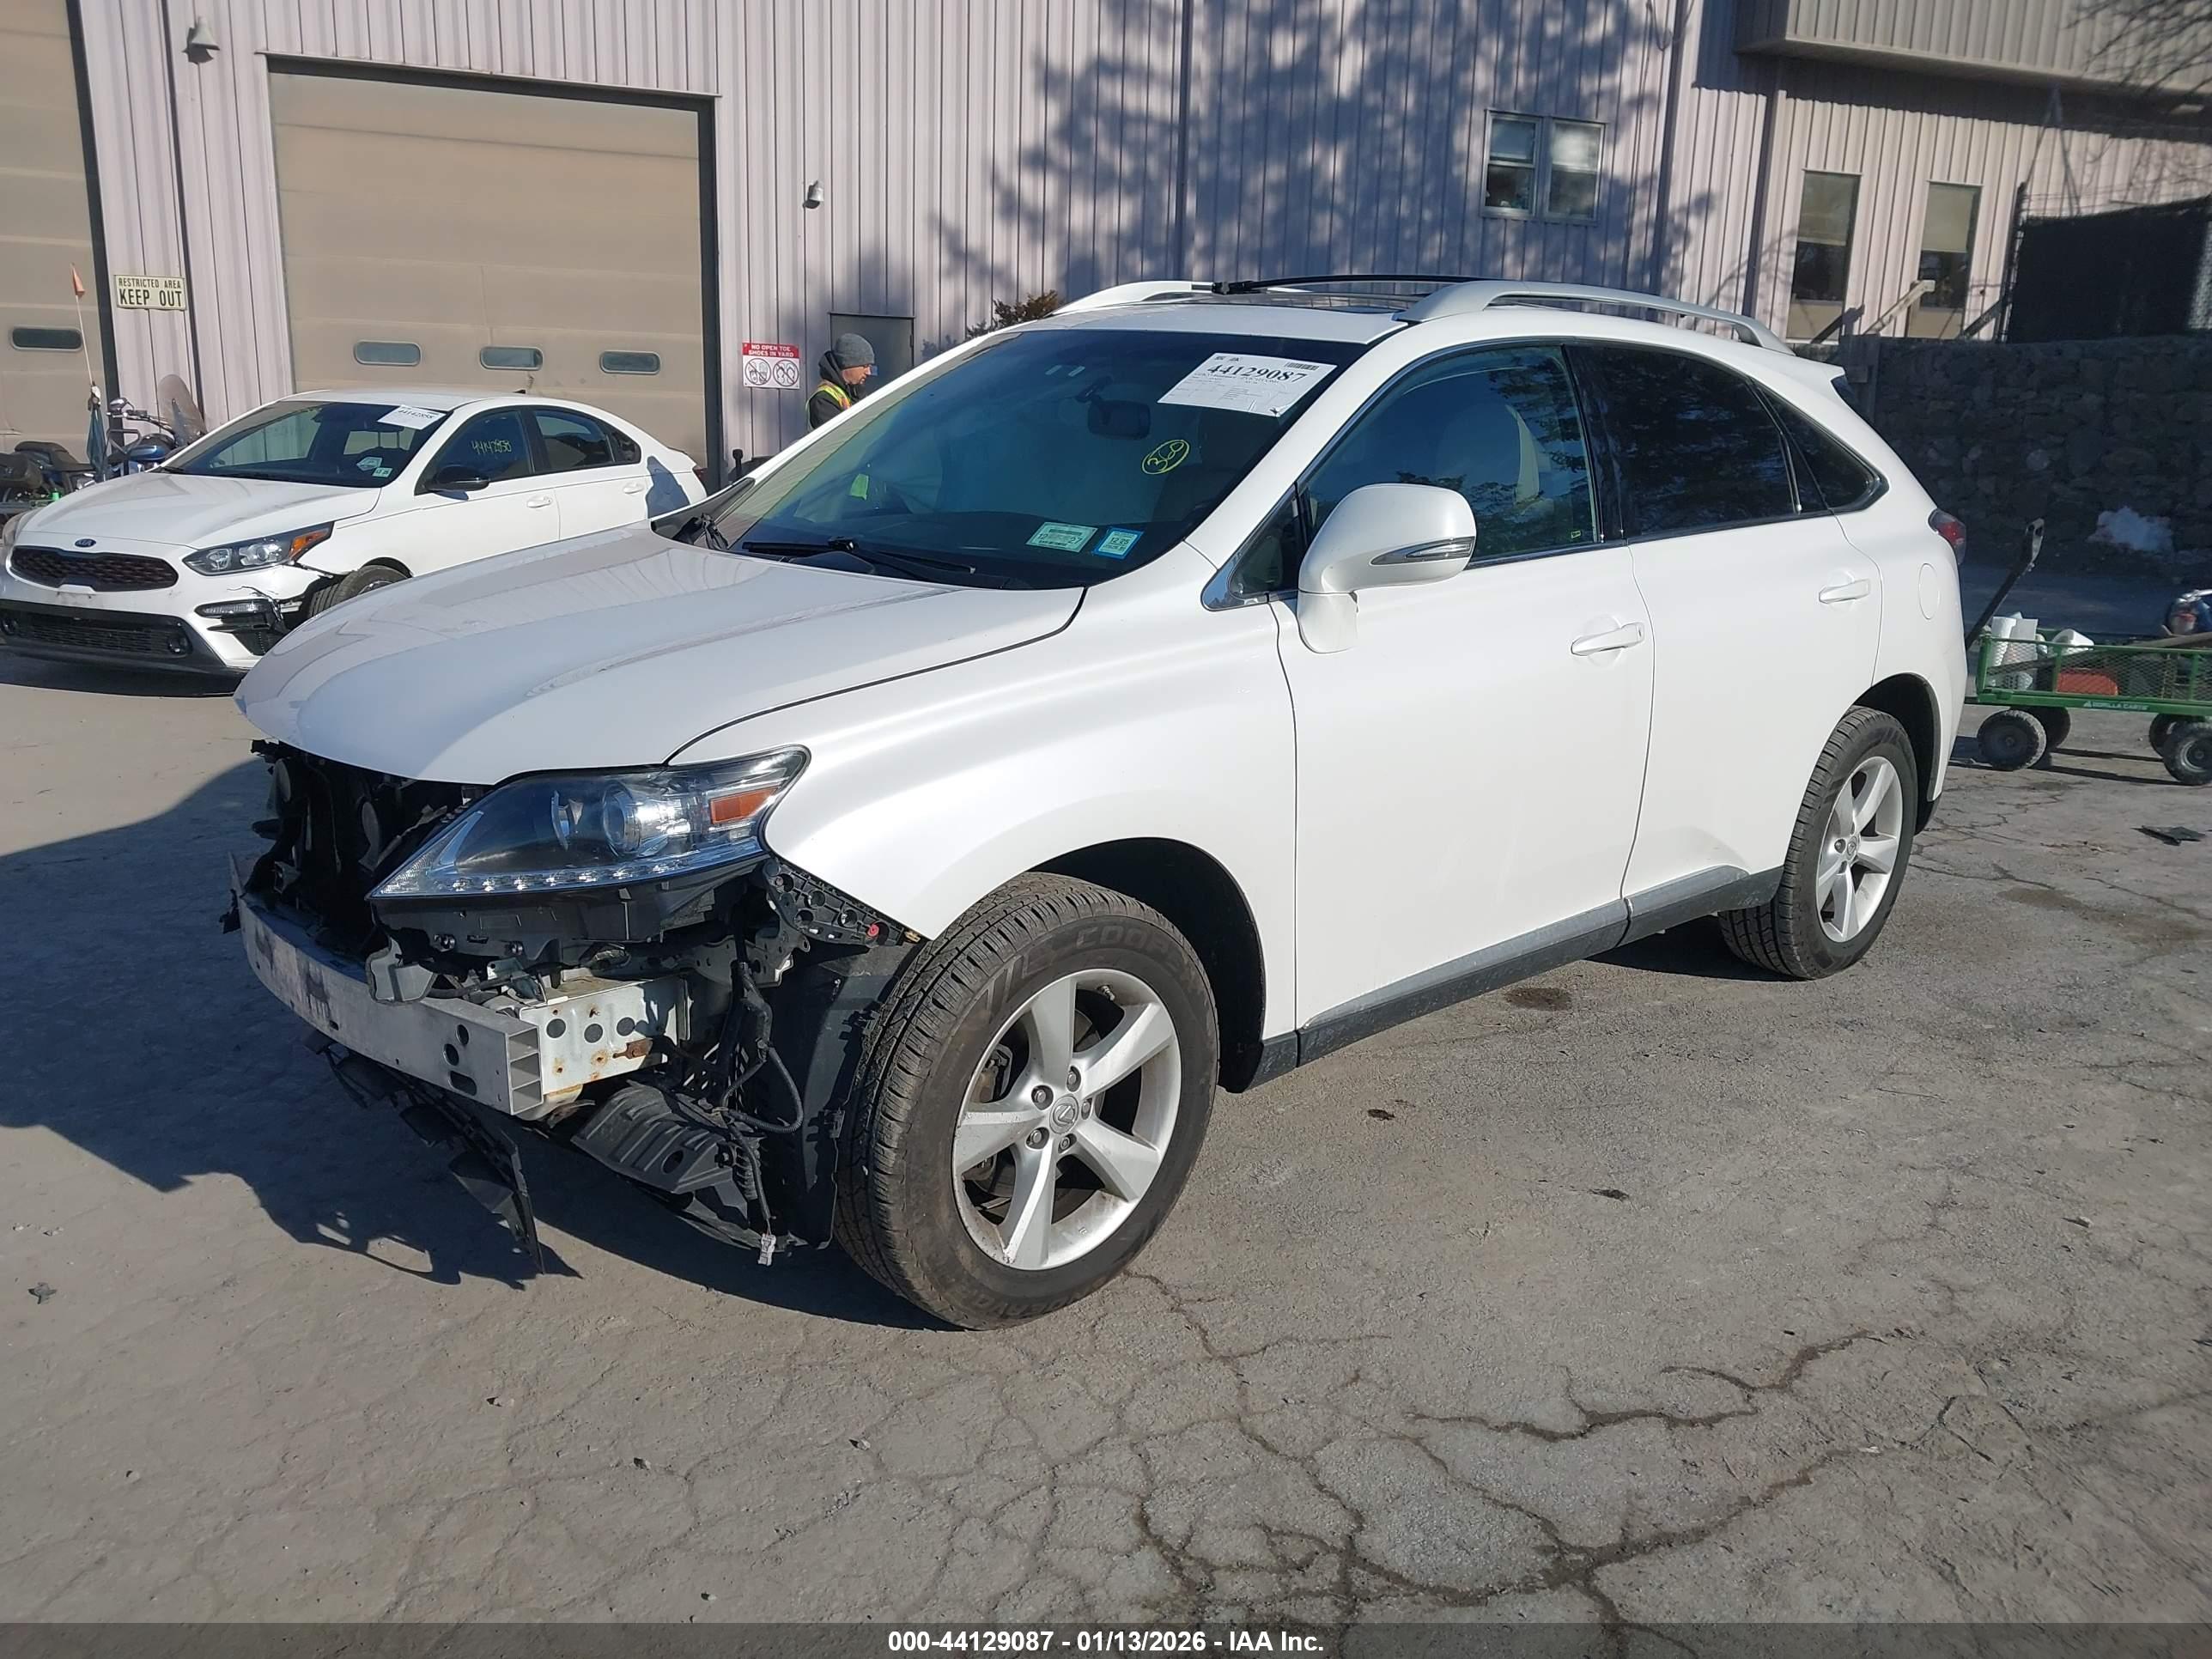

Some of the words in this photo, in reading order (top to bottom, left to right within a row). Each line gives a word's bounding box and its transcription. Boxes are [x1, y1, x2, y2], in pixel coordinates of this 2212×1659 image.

[118, 277, 160, 289] RESTRICTED
[164, 280, 181, 289] AREA
[119, 289, 150, 305] KEEP
[159, 290, 182, 307] OUT
[1207, 364, 1308, 383] 44129087
[1068, 536, 1083, 544] 27
